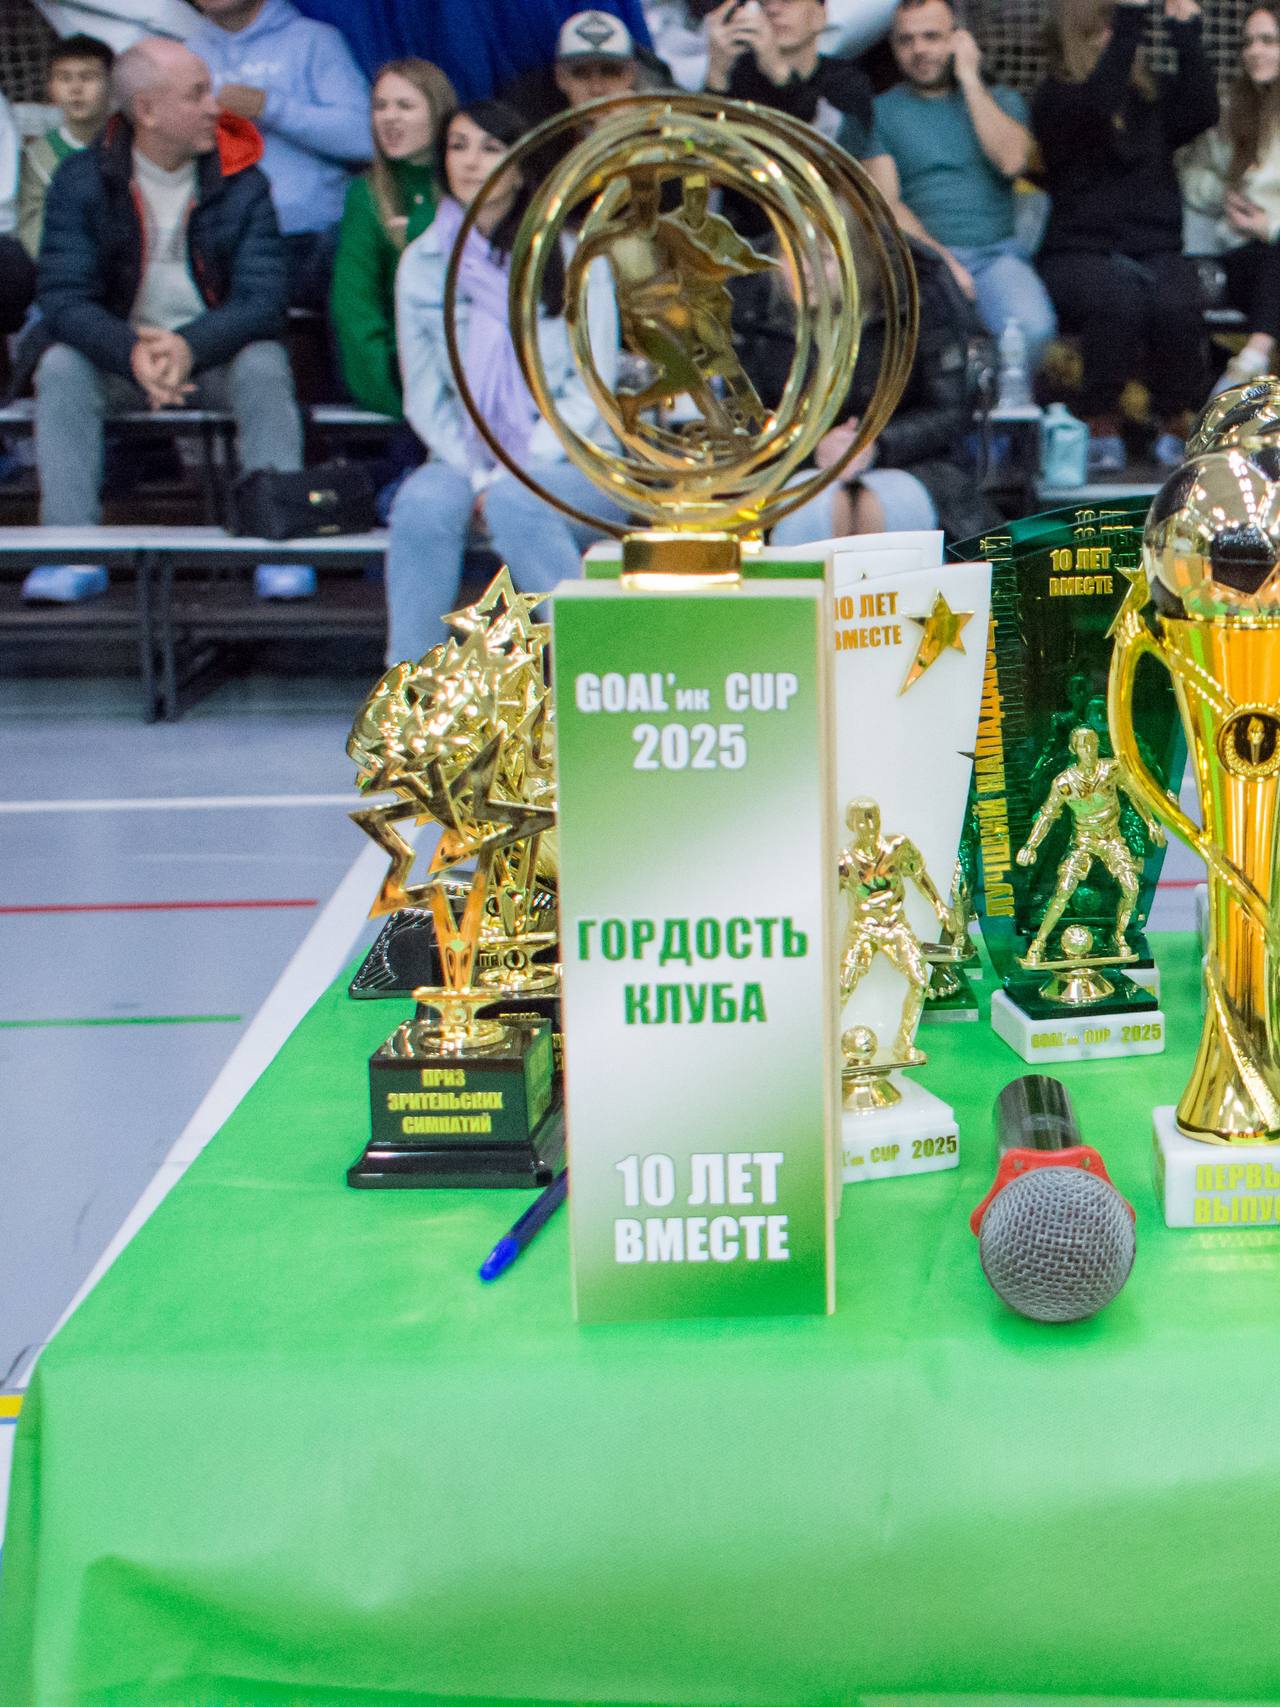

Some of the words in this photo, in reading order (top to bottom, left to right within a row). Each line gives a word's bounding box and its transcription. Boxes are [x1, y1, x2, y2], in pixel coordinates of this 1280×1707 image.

[1050, 548, 1072, 571] 10
[1076, 547, 1112, 569] ЛЕТ
[1049, 575, 1113, 597] ВМЕСТЕ
[859, 591, 899, 619] ЛЕТ
[724, 672, 799, 712] CUP
[633, 723, 748, 769] 2025
[973, 797, 1015, 917] ЛУЧШИЙ
[577, 916, 808, 967] ГОРДОСТЬ
[623, 982, 767, 1025] КЛУБА
[1084, 1027, 1111, 1045] CUP
[1121, 1024, 1162, 1044] 2025
[422, 1068, 466, 1088] ПРИЗ
[387, 1091, 503, 1110] ЗРИТЕЛЬСКИХ
[402, 1113, 491, 1134] СИМПАТИЙ
[870, 1144, 900, 1164] CUP
[912, 1135, 957, 1160] 2025
[614, 1153, 676, 1207] 10
[688, 1152, 784, 1206] ЛЕТ
[614, 1215, 790, 1263] ВМЕСТЕ
